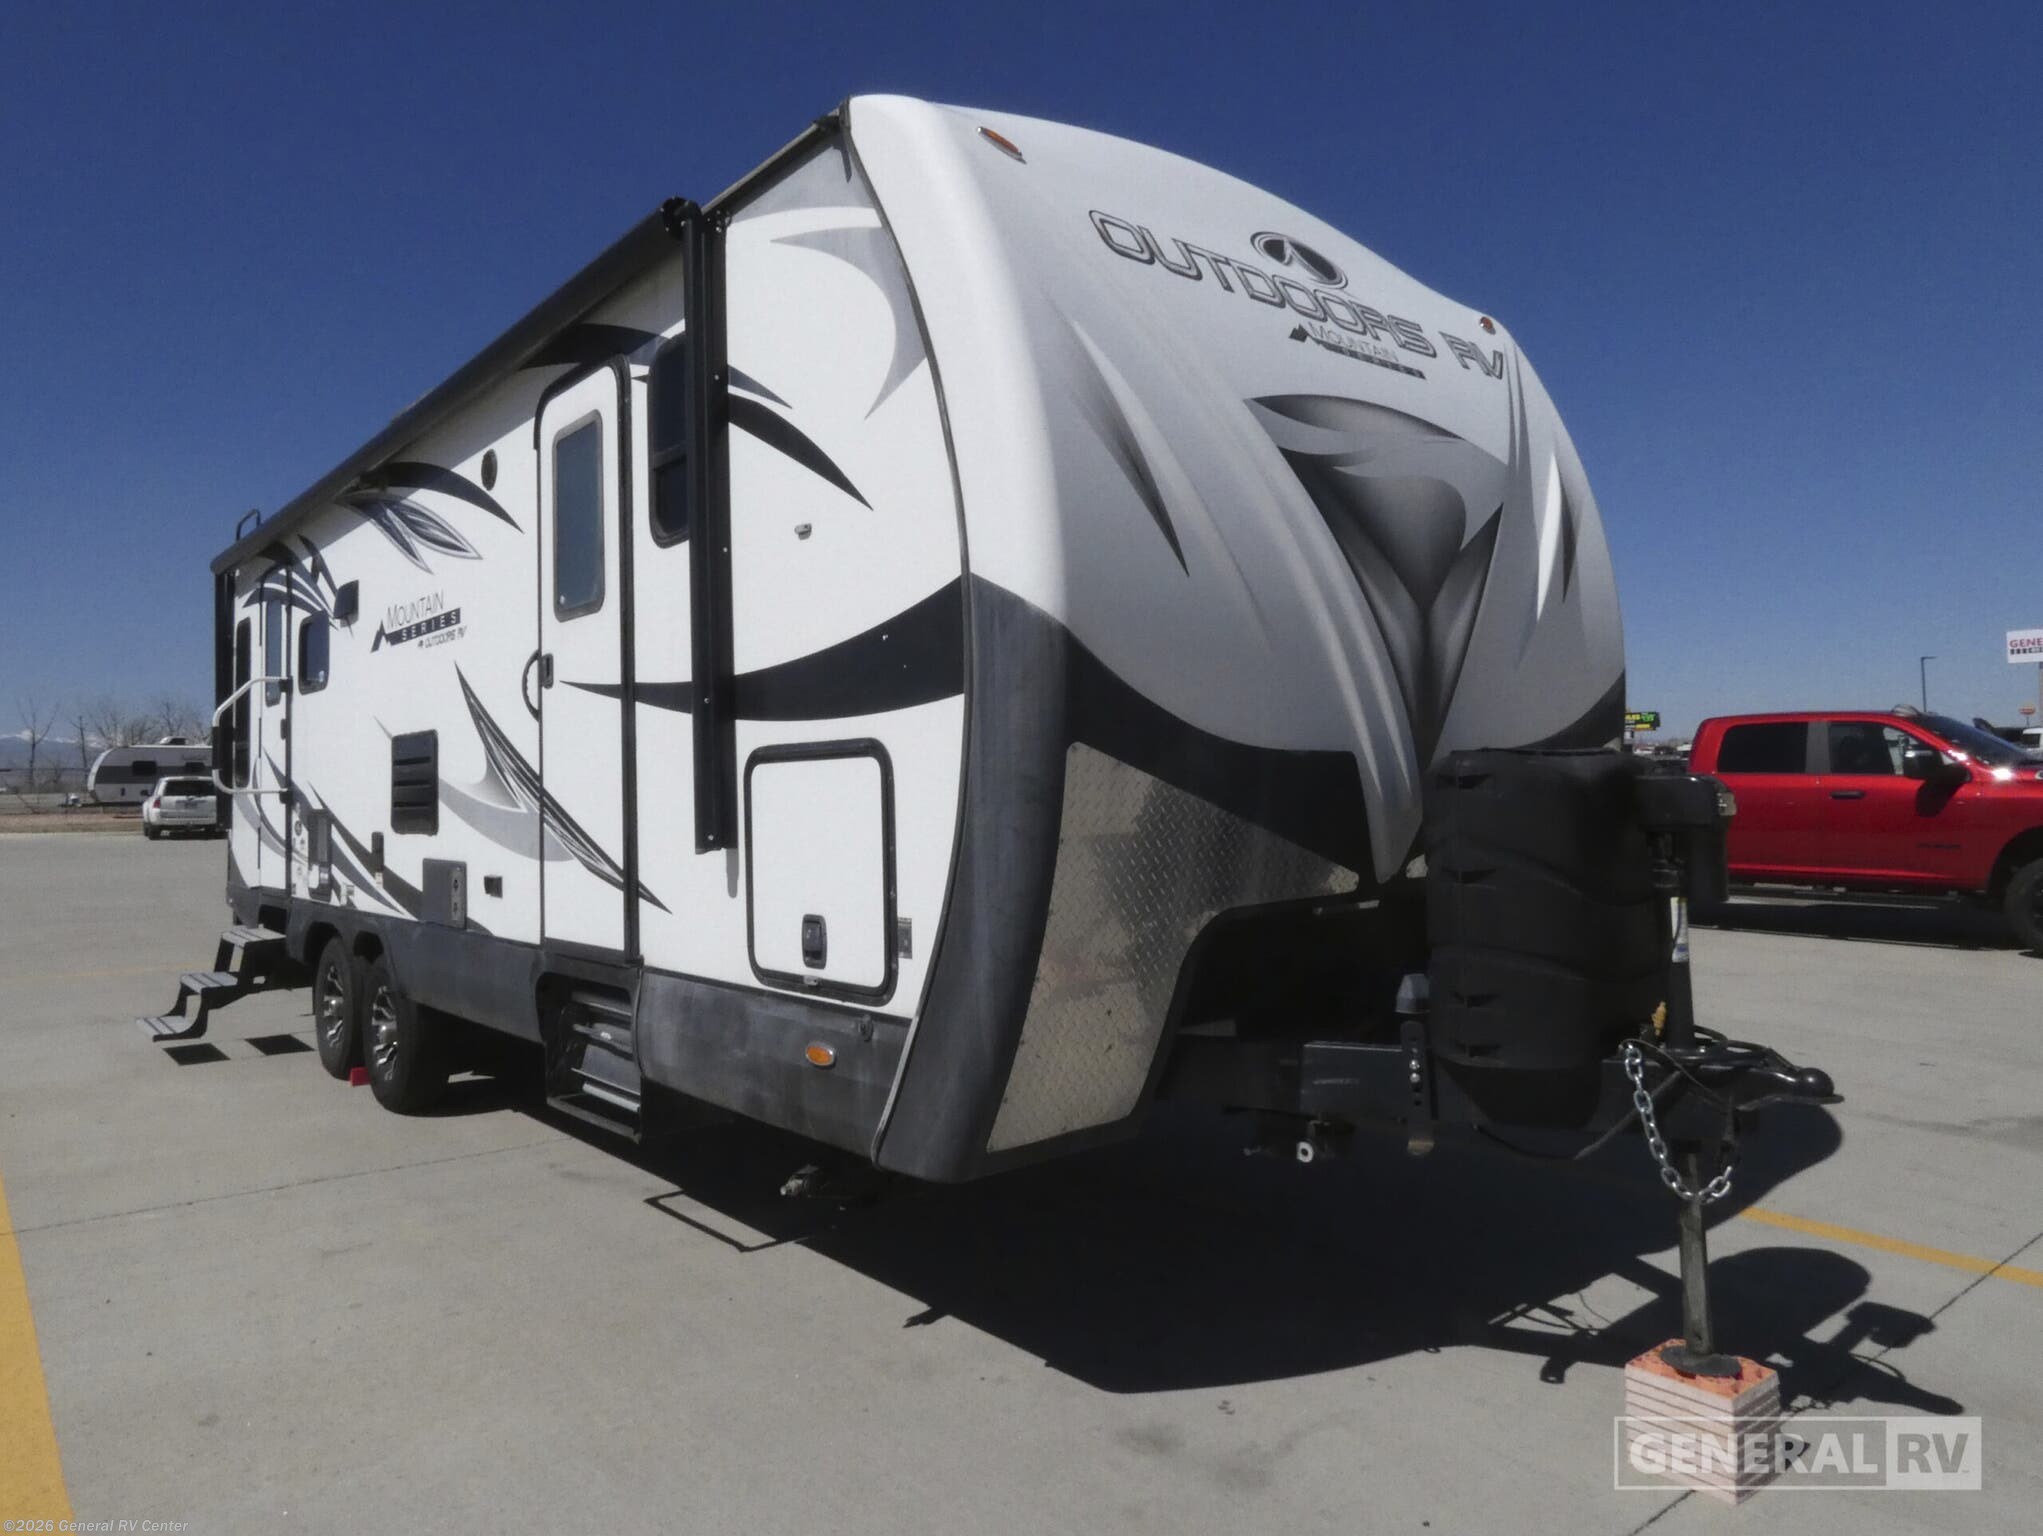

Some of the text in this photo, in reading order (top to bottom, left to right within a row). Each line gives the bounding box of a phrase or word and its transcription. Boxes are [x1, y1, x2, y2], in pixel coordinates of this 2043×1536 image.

[1089, 209, 1504, 381] OUTDOORS RV
[1307, 320, 1400, 363] MOUNTAIN
[387, 589, 444, 629] MOUNTAIN
[401, 610, 457, 641] SERIES
